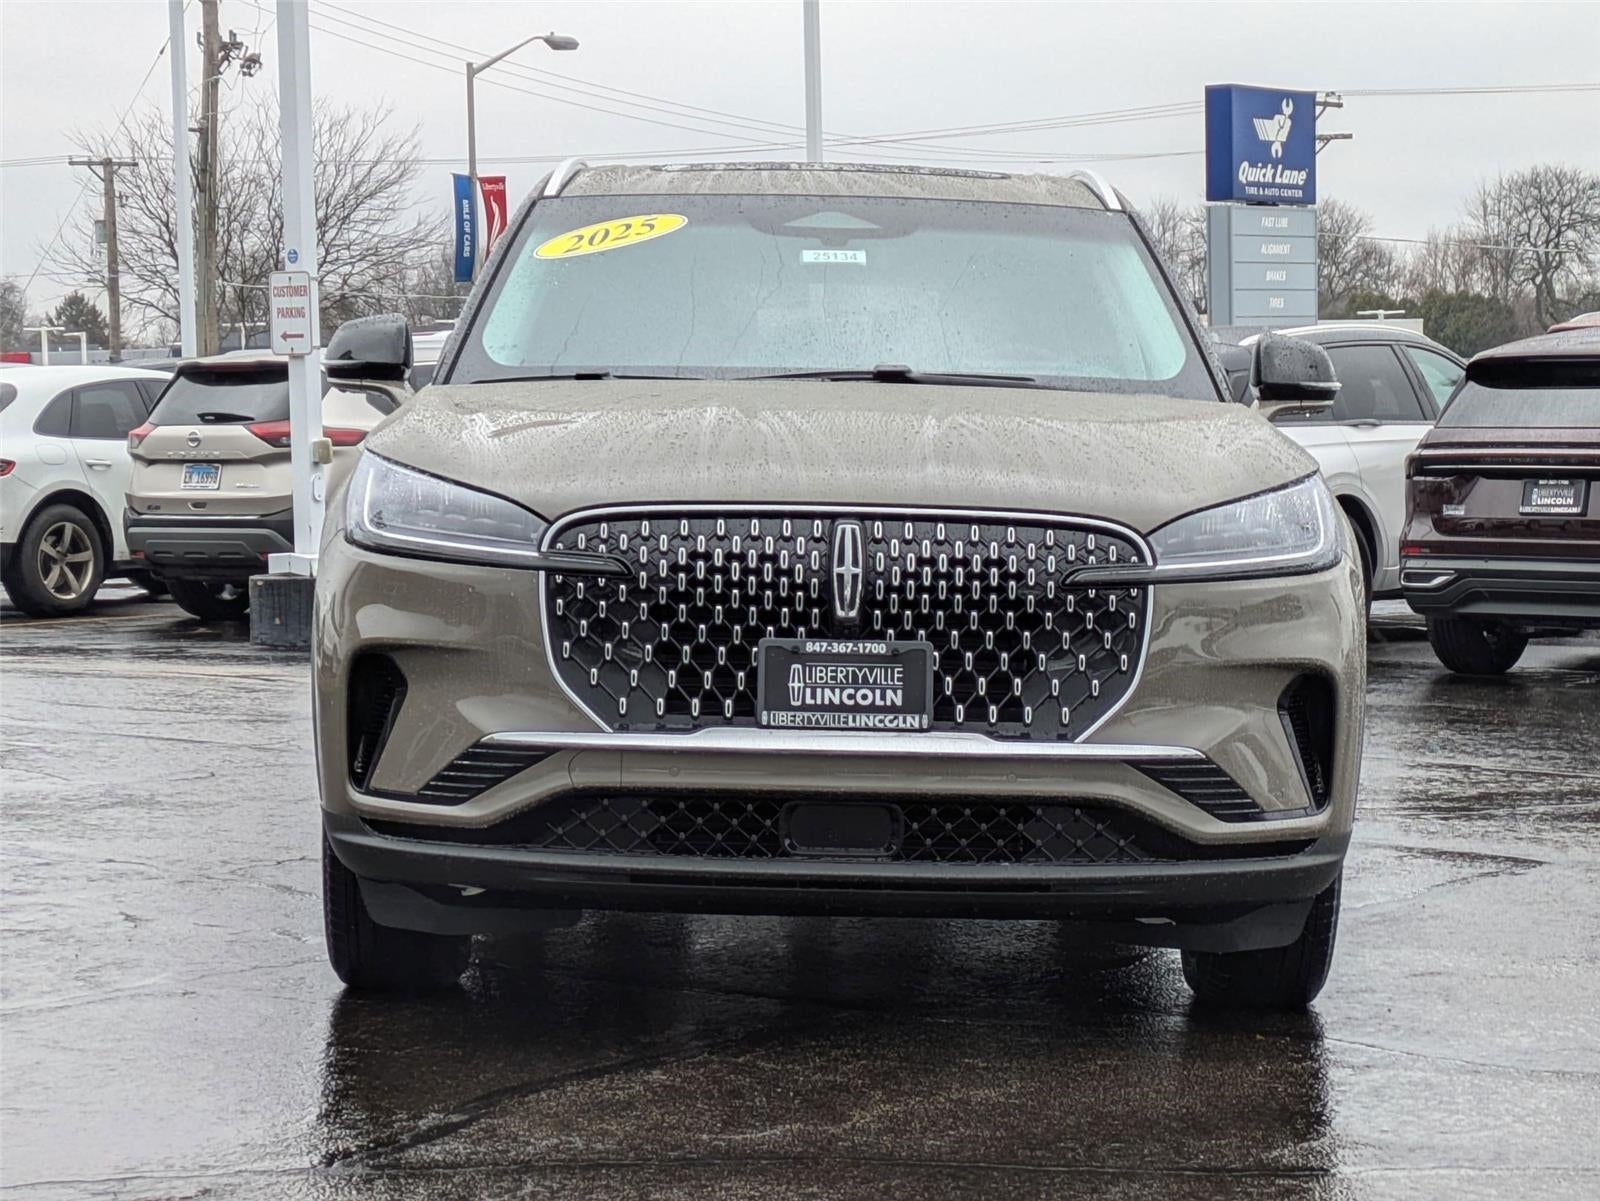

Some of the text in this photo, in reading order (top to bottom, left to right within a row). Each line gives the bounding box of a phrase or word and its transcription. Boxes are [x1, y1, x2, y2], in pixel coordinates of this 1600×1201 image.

[1239, 161, 1307, 185] Quick Lane
[1245, 186, 1258, 195] TIRE
[1264, 187, 1279, 196] AUTO
[1280, 188, 1303, 197] CENTER
[464, 220, 471, 232] OF
[1261, 216, 1275, 227] FAST
[564, 217, 659, 254] 2025
[463, 234, 471, 257] CARS
[813, 251, 858, 261] 25134
[273, 286, 307, 298] CUSTOMER
[276, 307, 306, 319] PARKING
[1537, 497, 1574, 505] LINCOLN
[805, 641, 886, 654] 847-367-1700
[805, 665, 904, 685] LIBERTYVILLE
[805, 688, 903, 707] LINCOLN
